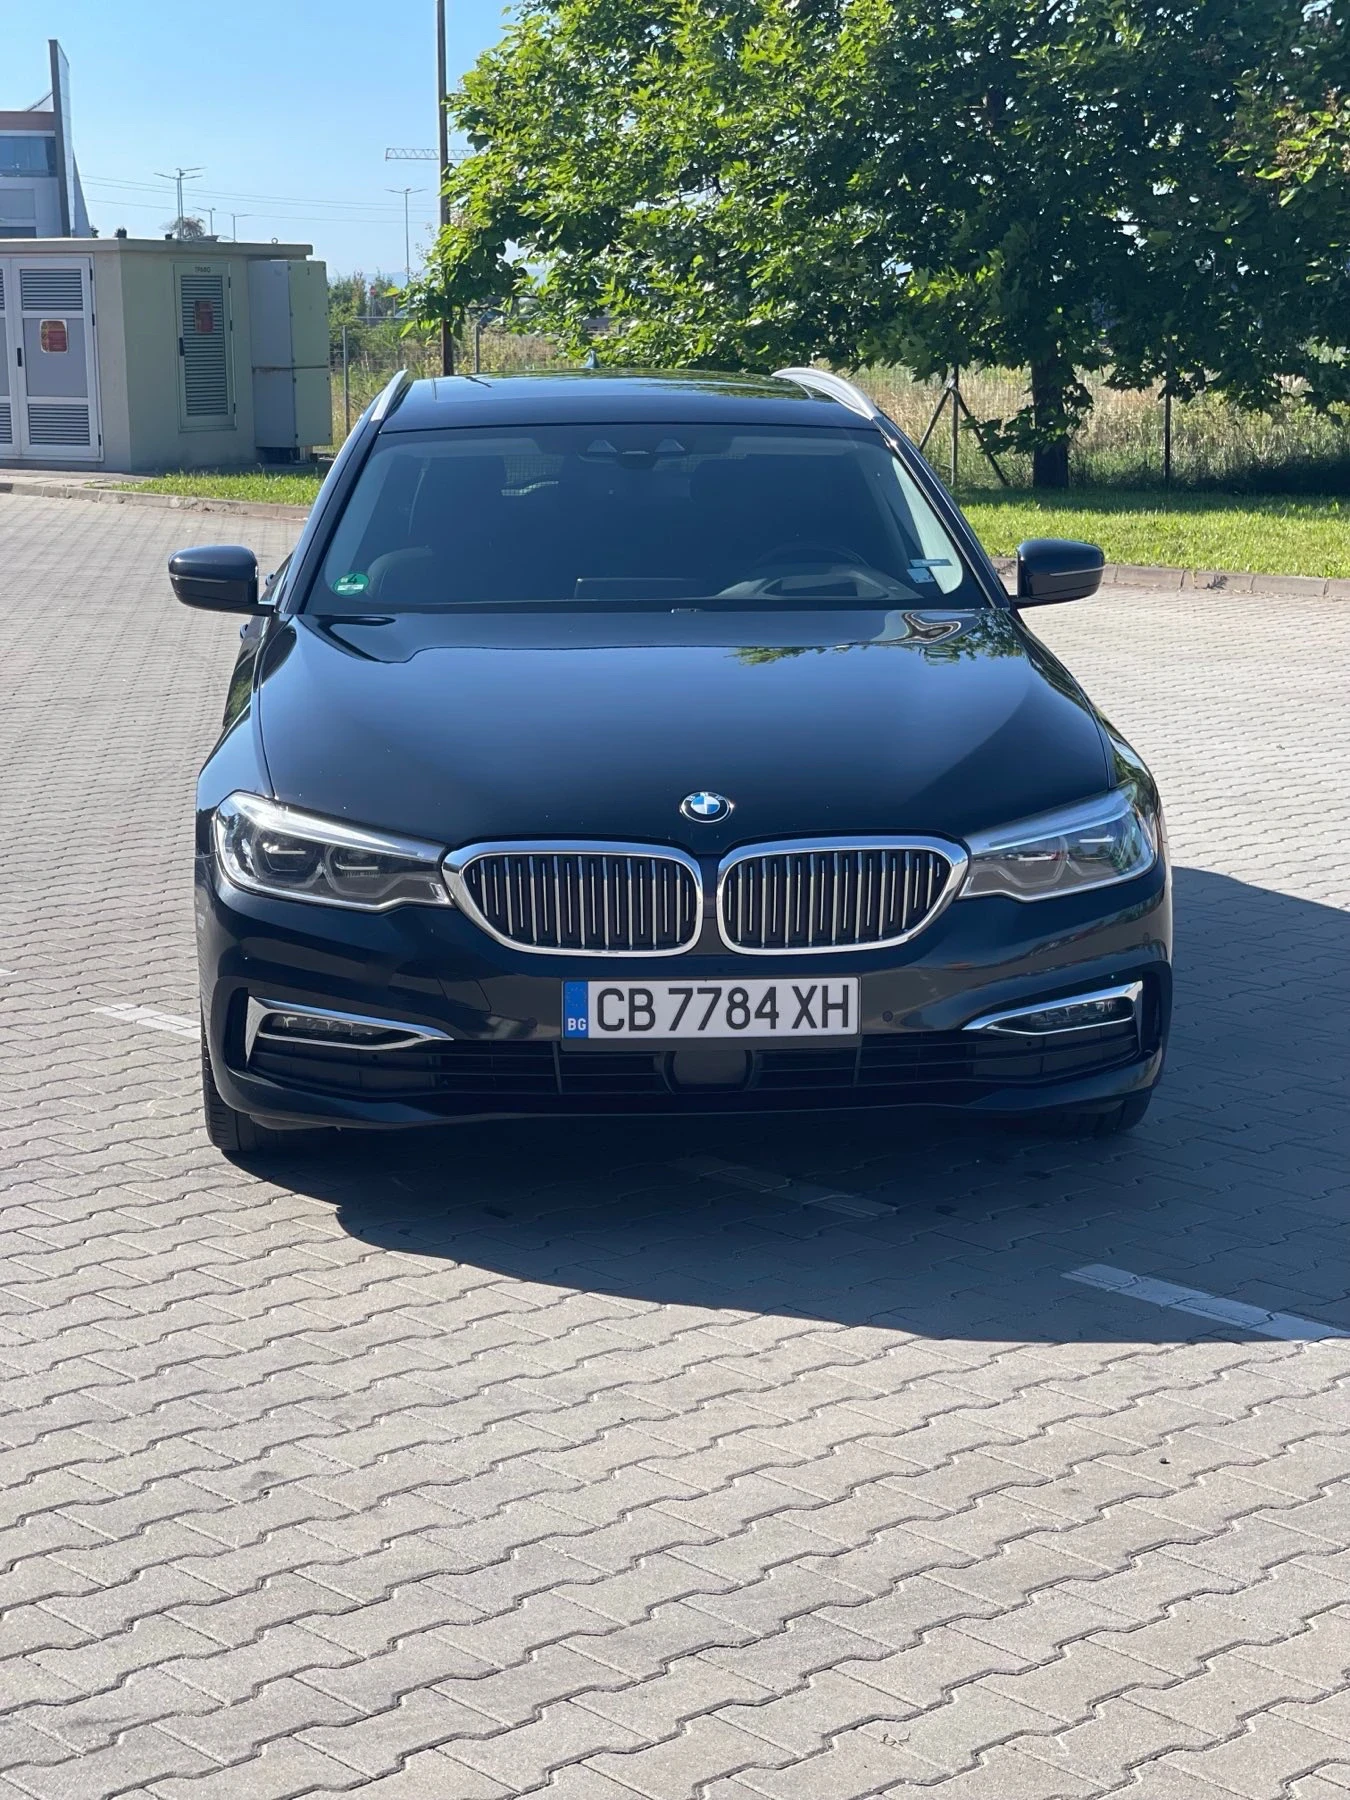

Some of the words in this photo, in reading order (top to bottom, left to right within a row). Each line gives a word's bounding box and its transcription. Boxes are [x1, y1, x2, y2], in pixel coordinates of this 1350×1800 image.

[597, 988, 656, 1032] CB
[668, 987, 780, 1031] 7784
[791, 984, 850, 1029] XH
[567, 1018, 587, 1031] BG
